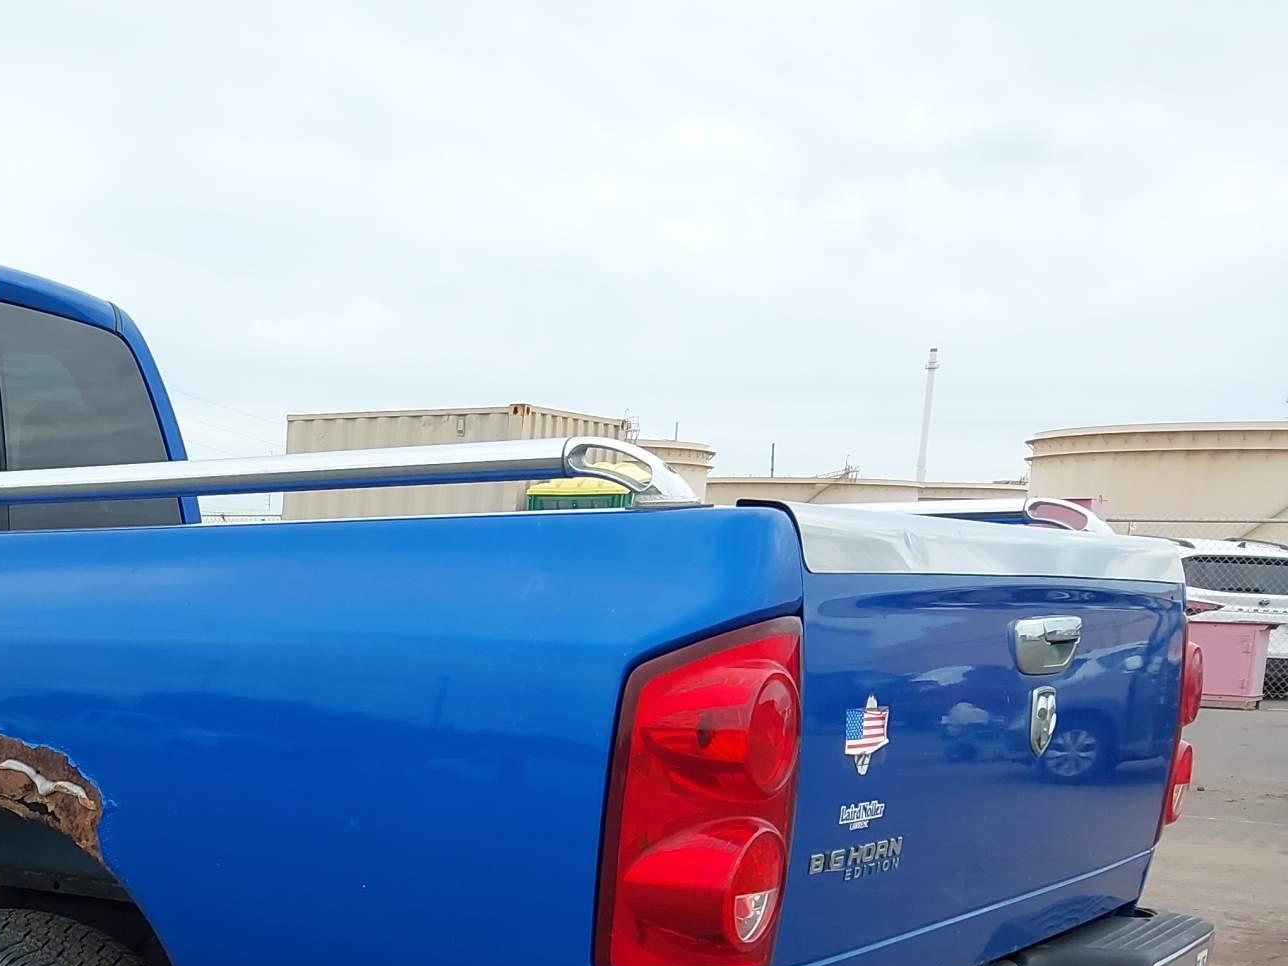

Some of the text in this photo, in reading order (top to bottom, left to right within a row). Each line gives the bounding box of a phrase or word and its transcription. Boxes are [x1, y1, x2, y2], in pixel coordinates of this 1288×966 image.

[809, 836, 903, 875] BIG HORN
[844, 857, 900, 881] EDITION
